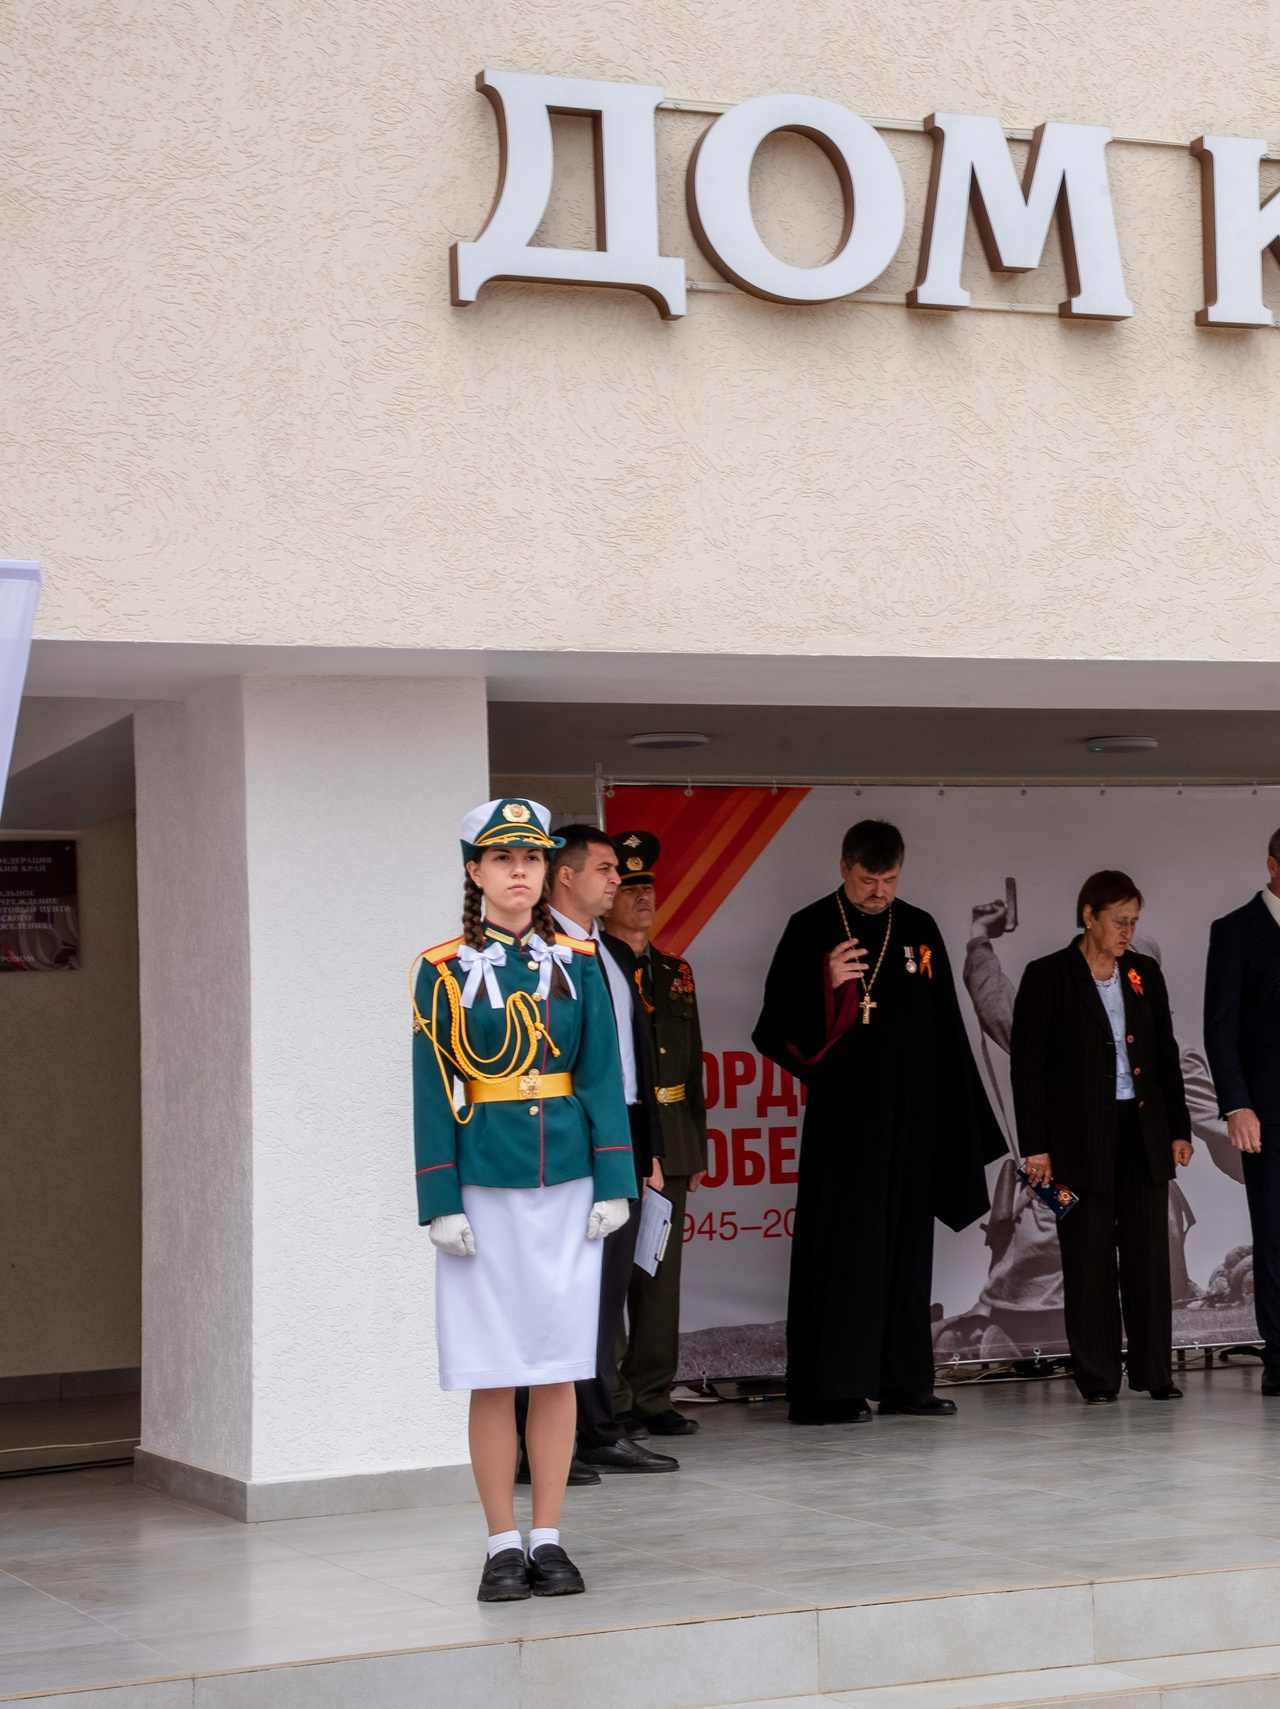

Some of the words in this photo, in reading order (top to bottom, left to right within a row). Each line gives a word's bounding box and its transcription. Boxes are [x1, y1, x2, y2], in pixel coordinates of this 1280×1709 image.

[450, 69, 1133, 321] ДОМ
[21, 864, 47, 872] КРАЙ
[39, 905, 70, 913] ЦЕНТР
[702, 1051, 807, 1118] ОРД
[700, 1126, 798, 1188] ОБЕ
